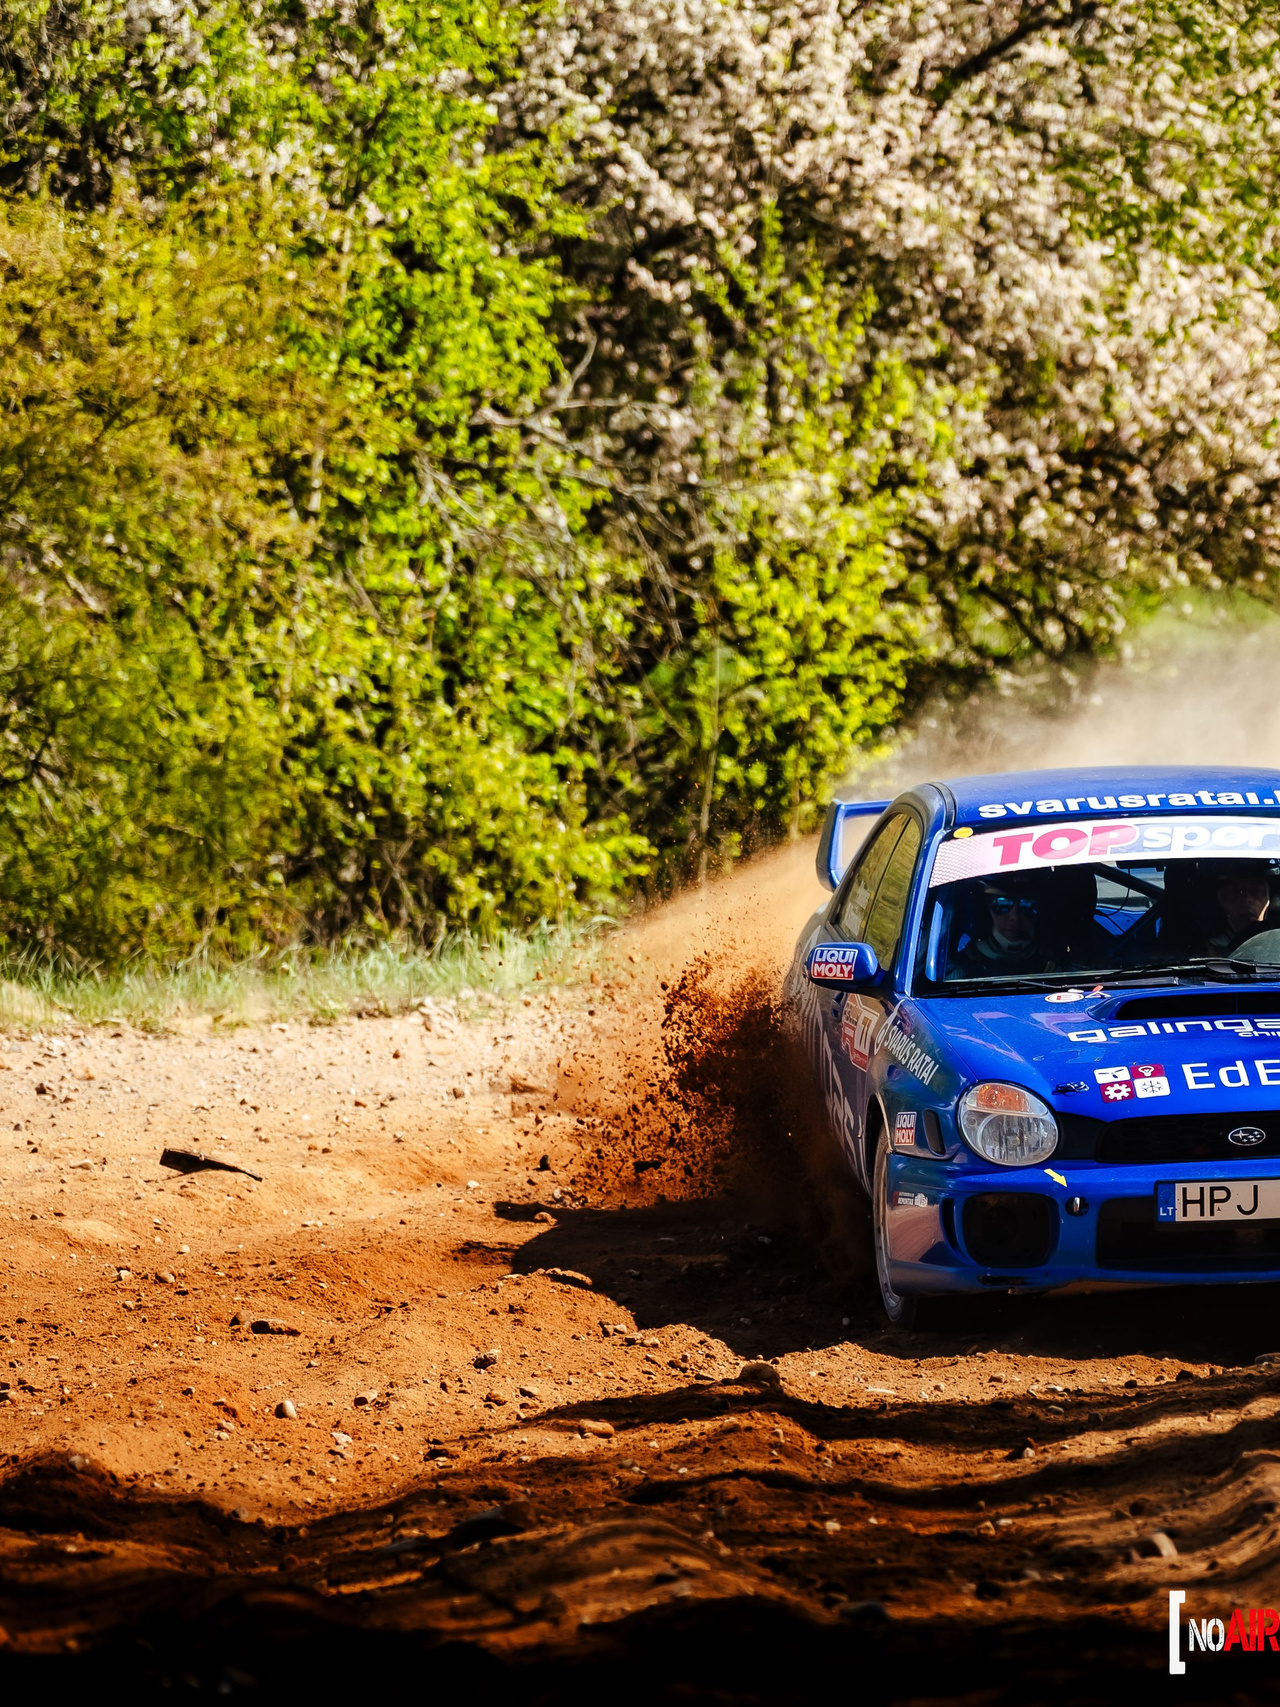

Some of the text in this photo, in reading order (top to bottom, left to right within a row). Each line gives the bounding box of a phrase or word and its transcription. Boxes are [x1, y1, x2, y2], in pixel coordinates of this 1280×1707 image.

[815, 950, 855, 963] LIQUI
[813, 963, 853, 977] MOLY
[906, 1047, 939, 1085] RATAI
[897, 1114, 915, 1128] LIQUI
[895, 1128, 914, 1143] MOLY
[1182, 1184, 1259, 1217] HPJ
[1159, 1206, 1173, 1216] LT
